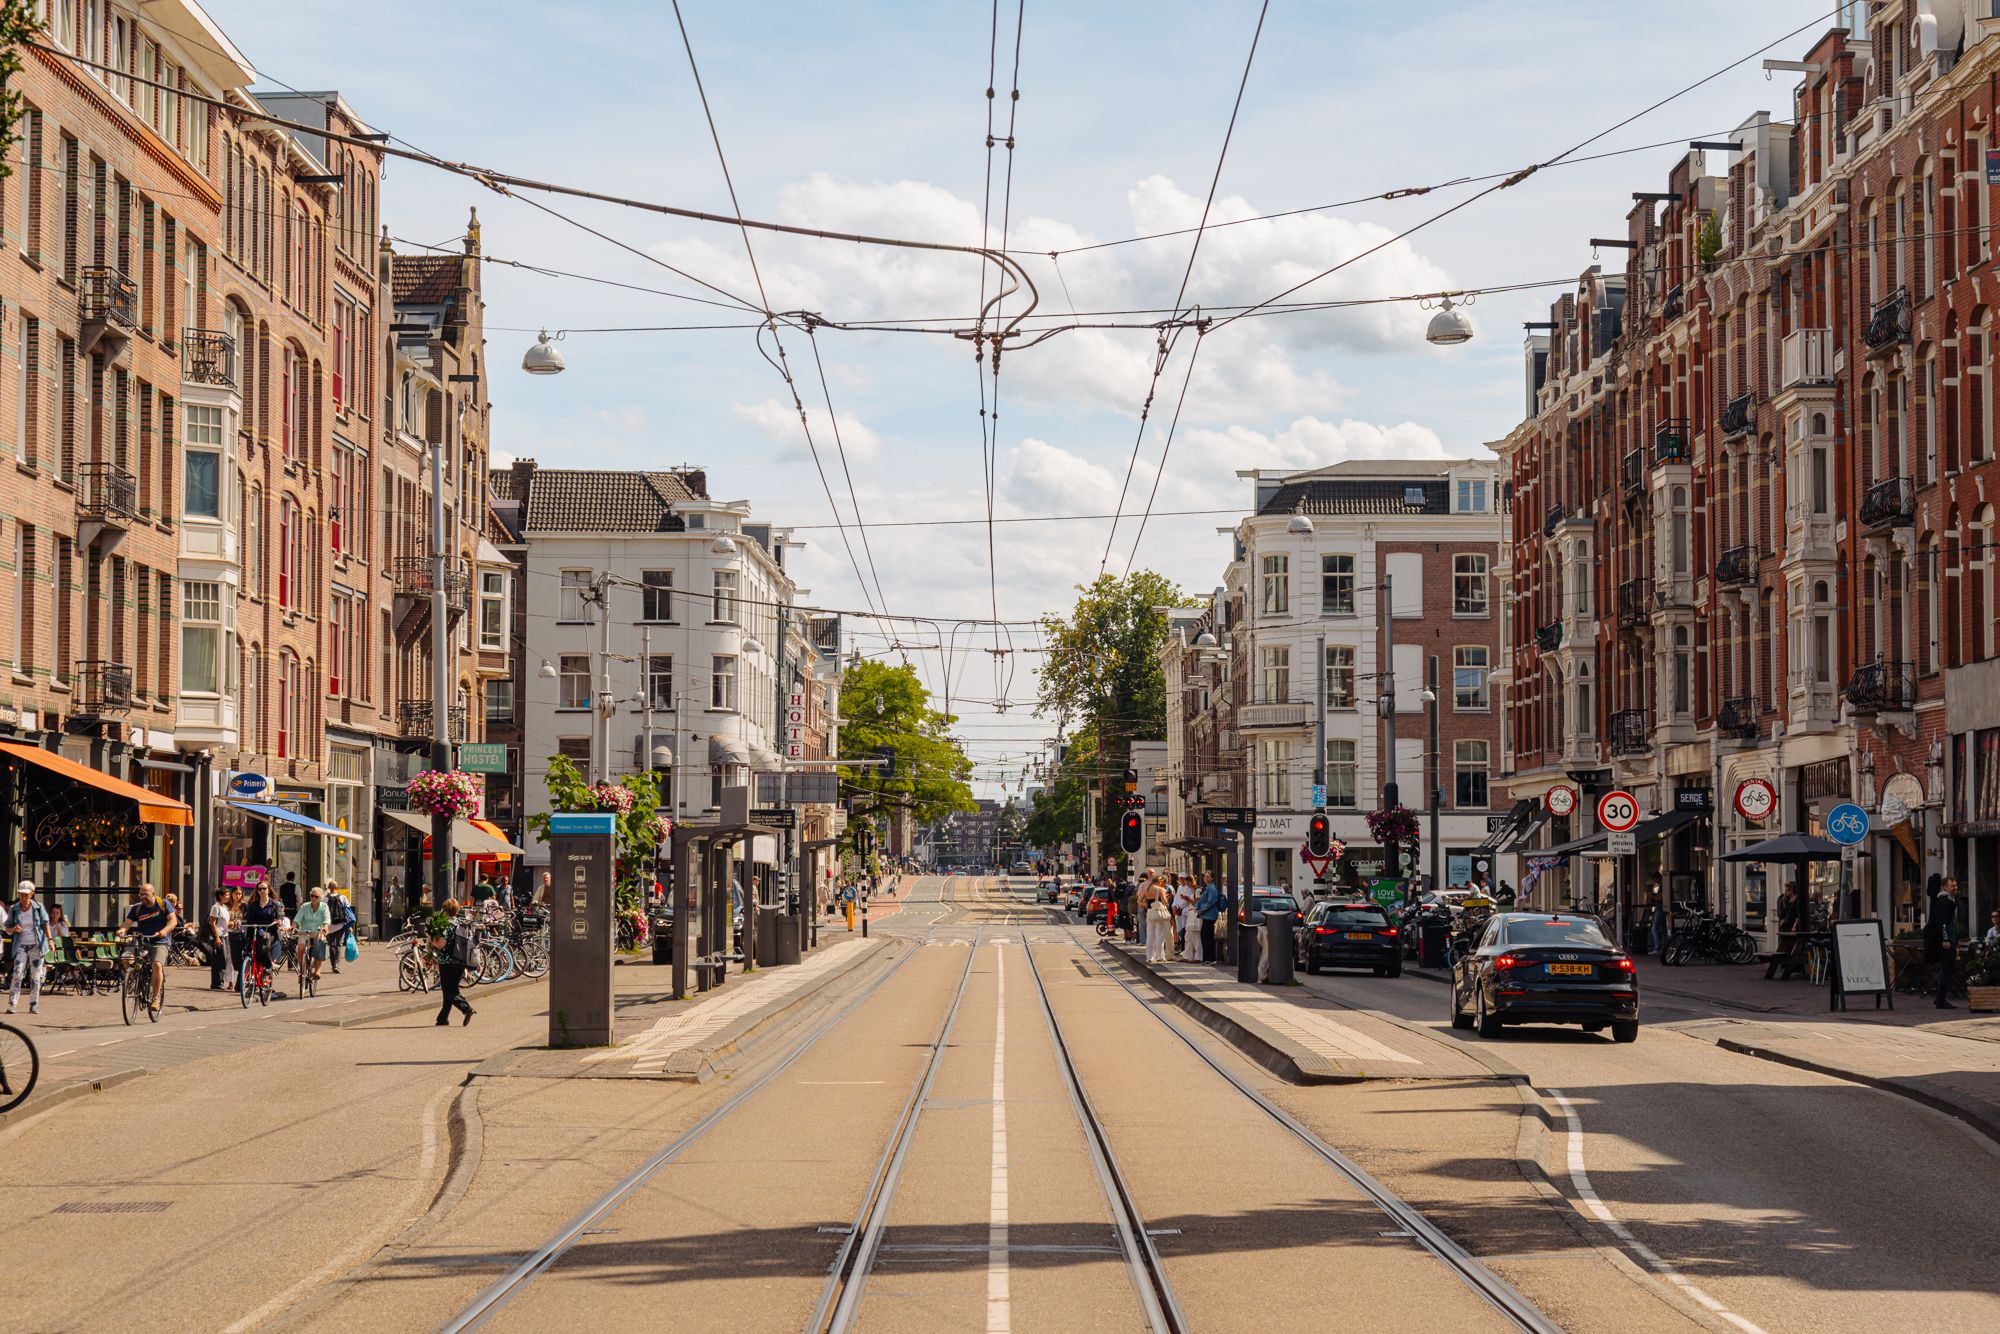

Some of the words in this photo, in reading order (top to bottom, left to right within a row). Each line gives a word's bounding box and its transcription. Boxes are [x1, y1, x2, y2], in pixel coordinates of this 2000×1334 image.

[790, 695, 801, 756] HOTE
[463, 754, 500, 765] HOSTEL
[382, 788, 408, 798] Janus
[1606, 804, 1632, 819] 30
[1270, 818, 1292, 829] MAT
